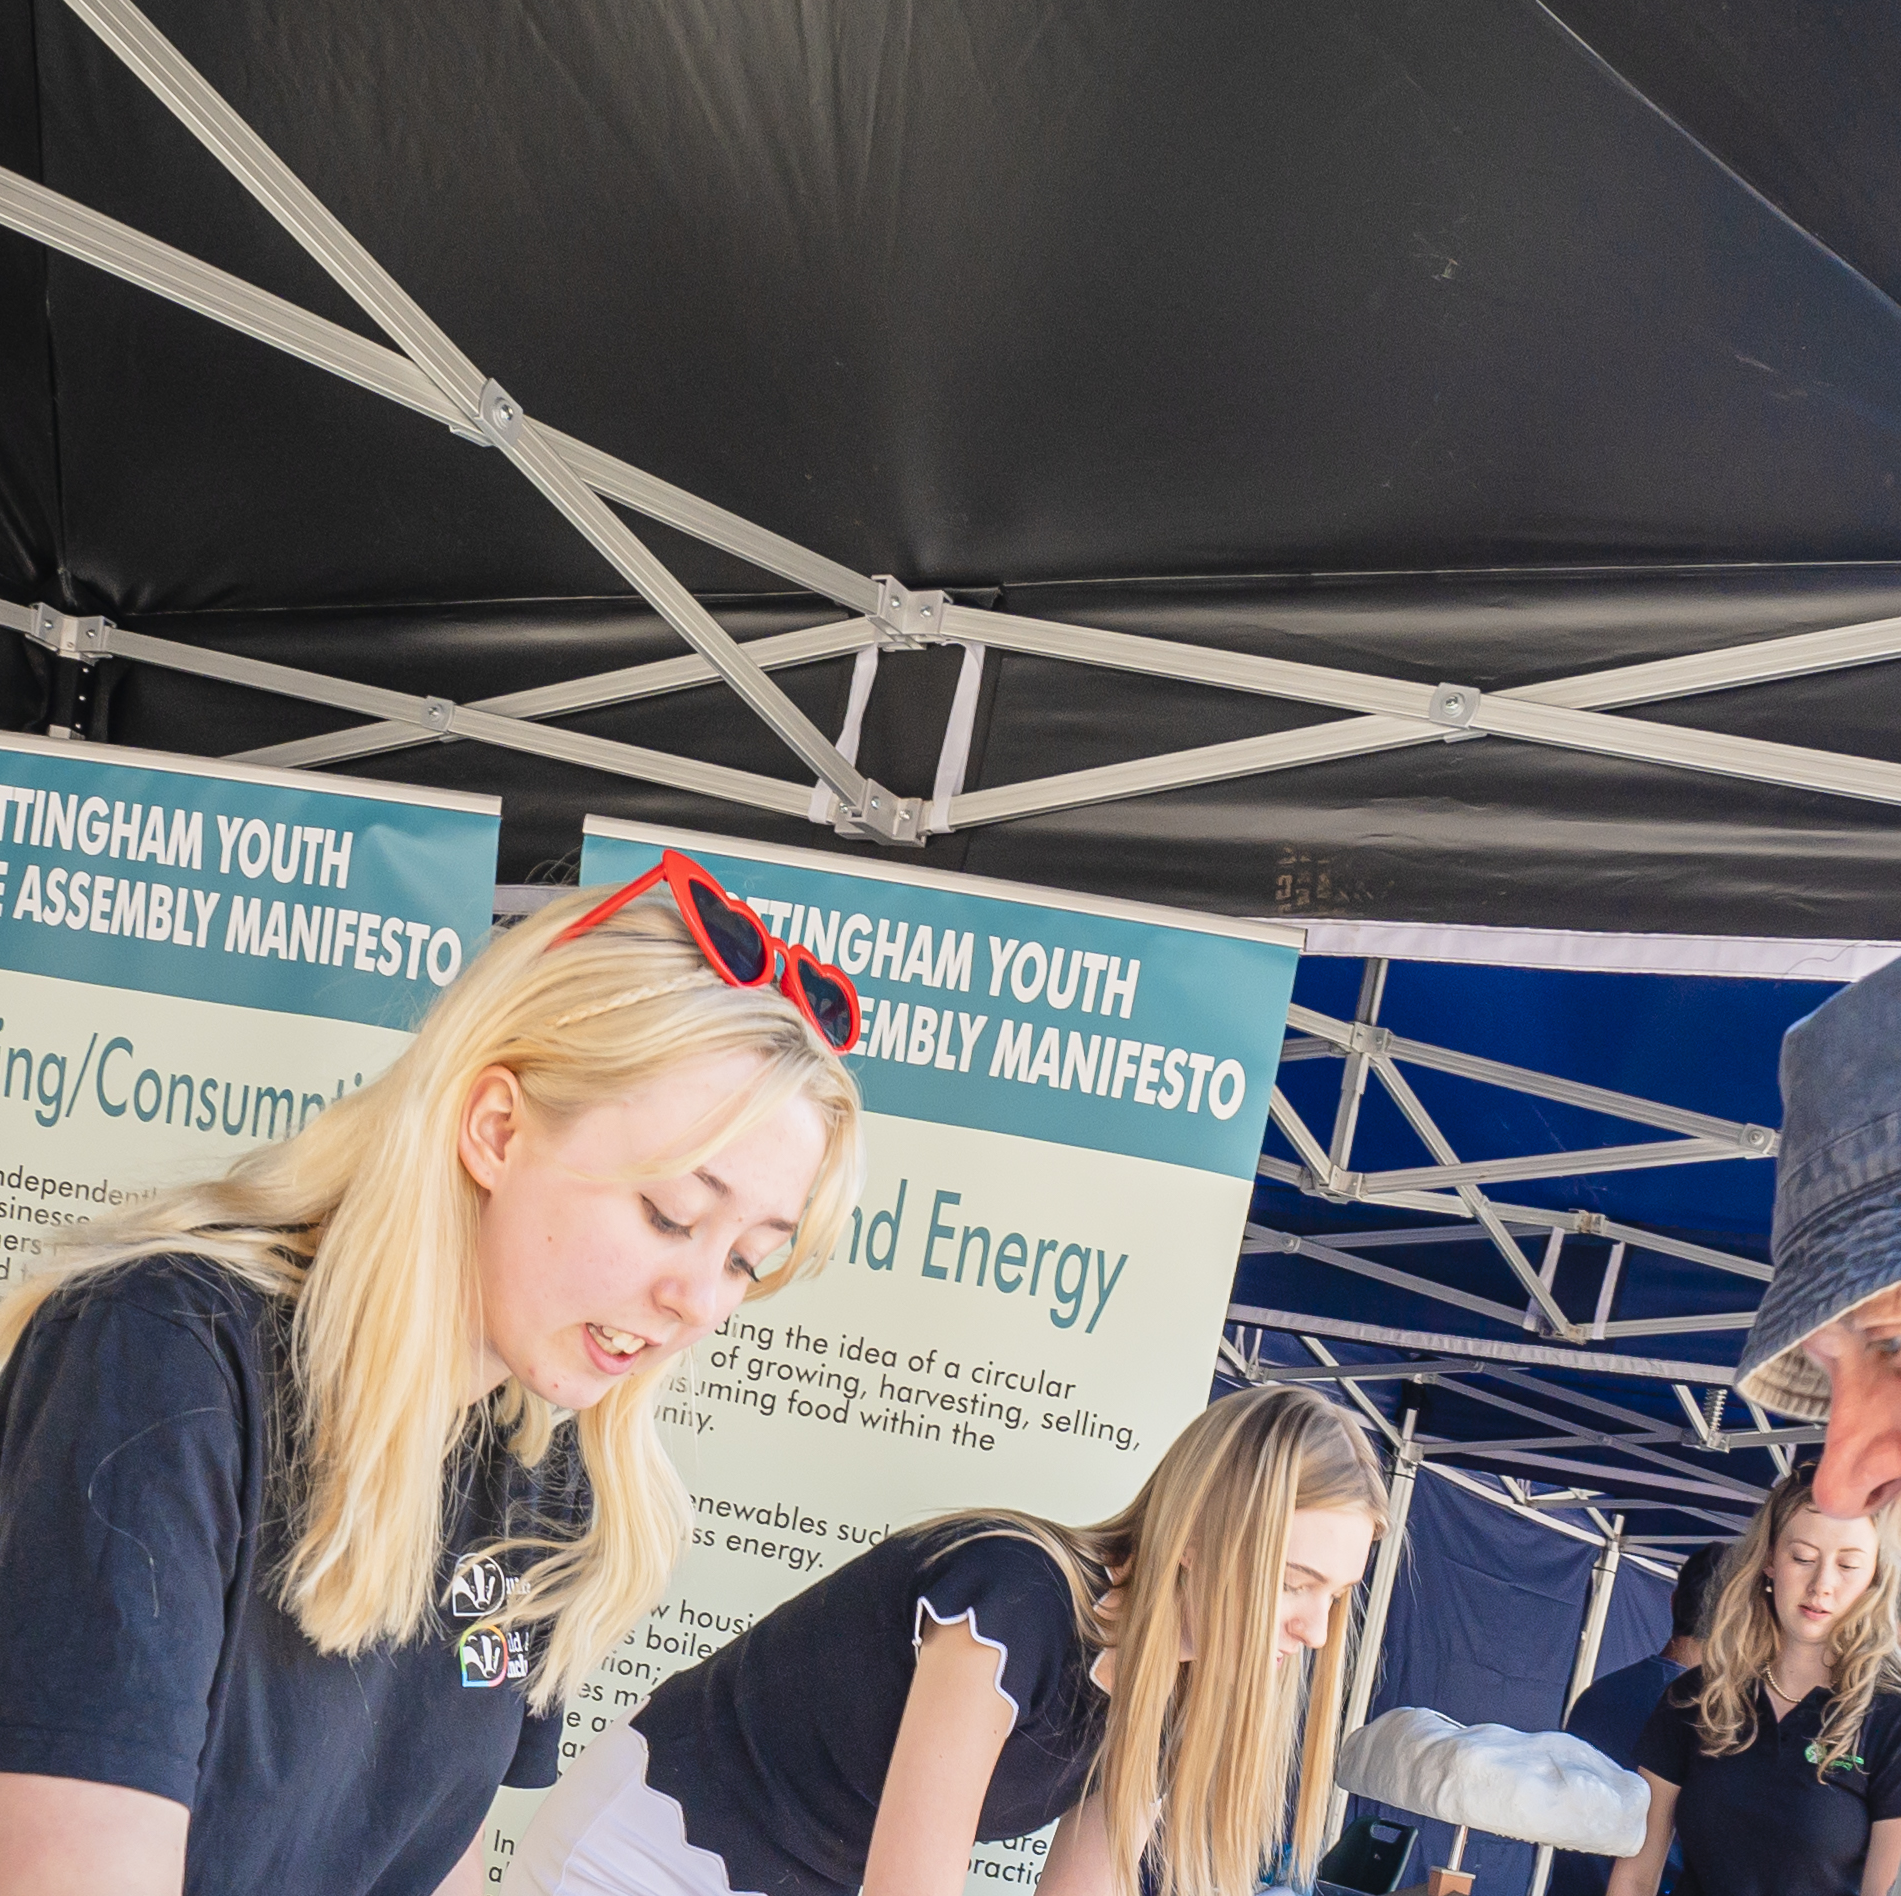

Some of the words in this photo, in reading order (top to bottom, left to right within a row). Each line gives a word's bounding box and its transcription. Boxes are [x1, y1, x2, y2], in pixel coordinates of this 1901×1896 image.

[215, 814, 354, 890] YOUTH
[11, 864, 220, 949] ASSEMBLY
[224, 894, 463, 987] MANIFESTO
[744, 896, 976, 993] TTINGHAM
[987, 935, 1142, 1020] YOUTH
[851, 995, 989, 1074] EMBLY
[988, 1018, 1247, 1122] MANIFESTO
[847, 1178, 908, 1271] nd
[920, 1188, 1128, 1335] Energy
[710, 1345, 741, 1370] of
[746, 1354, 868, 1400] growing,
[880, 1374, 1030, 1431] harvesting,
[1040, 1407, 1142, 1454] selling,
[715, 1314, 774, 1351] ding
[784, 1325, 829, 1356] the
[838, 1335, 898, 1368] idea
[907, 1349, 939, 1374] of
[944, 1358, 961, 1379] a
[971, 1361, 1077, 1400] circular
[787, 1390, 850, 1425] food
[859, 1406, 942, 1442] within
[952, 1422, 996, 1452] the
[726, 1536, 825, 1571] energy.
[646, 1623, 721, 1660] boile
[679, 1598, 754, 1635] housi
